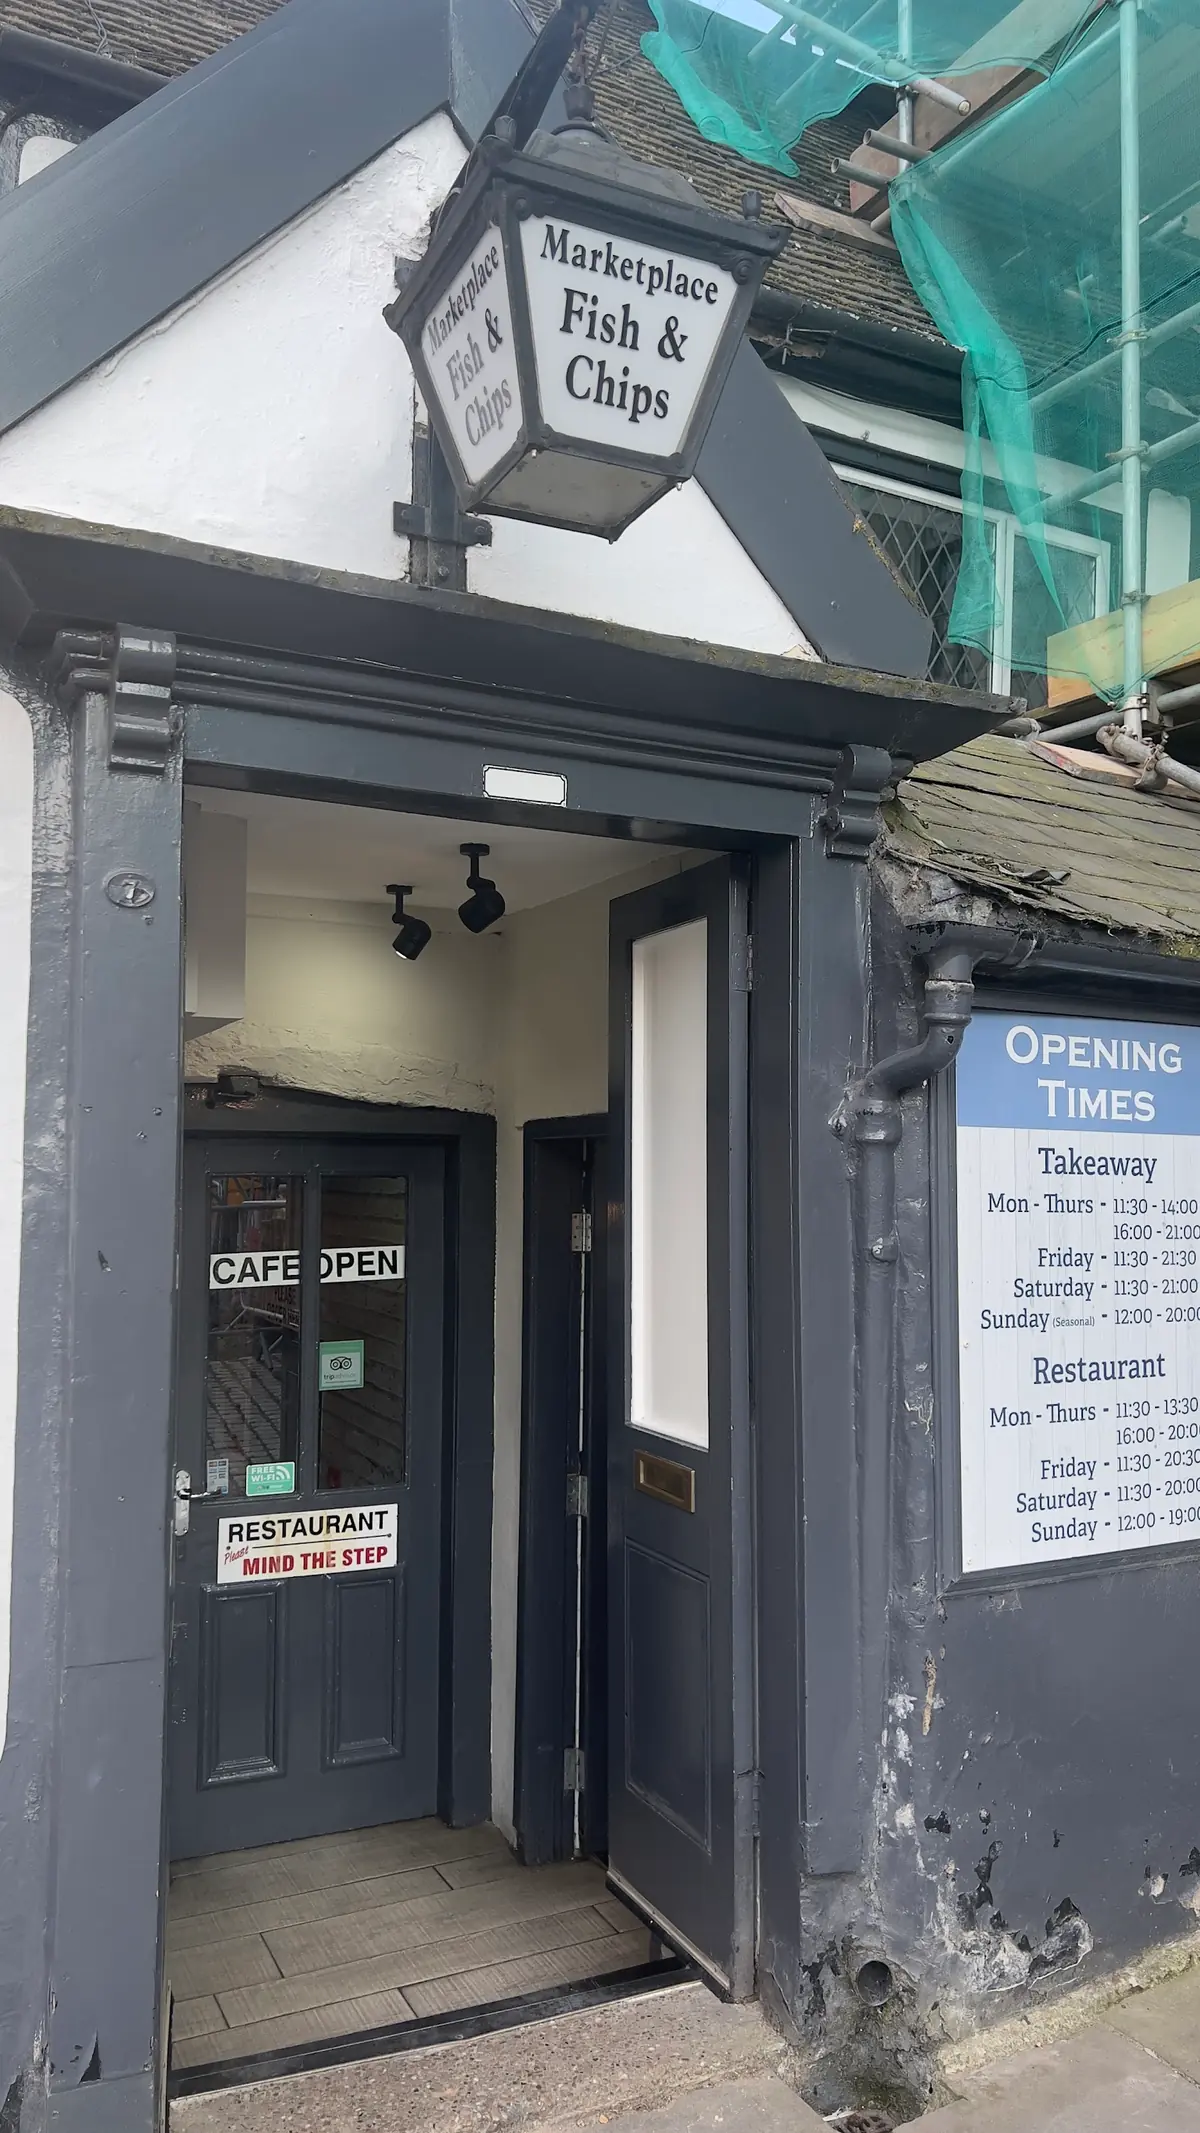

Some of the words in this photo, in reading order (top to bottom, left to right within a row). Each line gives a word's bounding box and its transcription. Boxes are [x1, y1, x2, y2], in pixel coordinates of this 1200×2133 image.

[540, 224, 718, 304] Marketplace
[426, 245, 499, 355] Marketplace
[559, 287, 640, 350] Fish
[657, 316, 688, 362] &
[446, 333, 484, 400] Fish
[485, 308, 502, 353] &
[565, 355, 670, 423] Chips
[465, 378, 512, 447] Chips
[1038, 1148, 1157, 1183] Takeaway
[988, 1193, 1029, 1212] Mon
[1044, 1194, 1093, 1213] Thurs
[1114, 1199, 1147, 1215] 11:30
[1162, 1200, 1197, 1215] 14:00
[1114, 1223, 1152, 1240] 16:00
[213, 1256, 299, 1284] CAFE
[1038, 1247, 1093, 1271] Friday
[1114, 1251, 1148, 1267] 11:30
[1162, 1251, 1196, 1267] 21:30
[1014, 1277, 1094, 1301] Saturday
[1115, 1280, 1148, 1296] 11:30
[1162, 1279, 1198, 1293] 21:00
[981, 1308, 1049, 1332] Sunday
[1053, 1316, 1094, 1328] (Seasonal)
[1115, 1309, 1152, 1324] 12:00
[1034, 1354, 1165, 1384] Restaurant
[990, 1407, 1031, 1427] Mon
[1047, 1403, 1095, 1423] Thurs
[1117, 1401, 1150, 1418] 11:30
[1164, 1397, 1198, 1415] 13:30
[1117, 1427, 1154, 1445] 16:00
[1169, 1423, 1200, 1440] 20:0
[251, 1466, 275, 1474] FREE
[251, 1474, 275, 1482] WI-FI
[1041, 1457, 1096, 1480] Friday
[1118, 1454, 1151, 1472] 11:30
[1017, 1487, 1097, 1513] Saturday
[1118, 1483, 1151, 1501] 11:30
[229, 1511, 388, 1543] RESTAURANT
[1032, 1518, 1097, 1542] Sunday
[1118, 1512, 1155, 1531] 12:00
[224, 1546, 249, 1565] Please
[243, 1555, 294, 1575] MIND
[300, 1551, 336, 1570] THE
[342, 1546, 387, 1566] STEP
